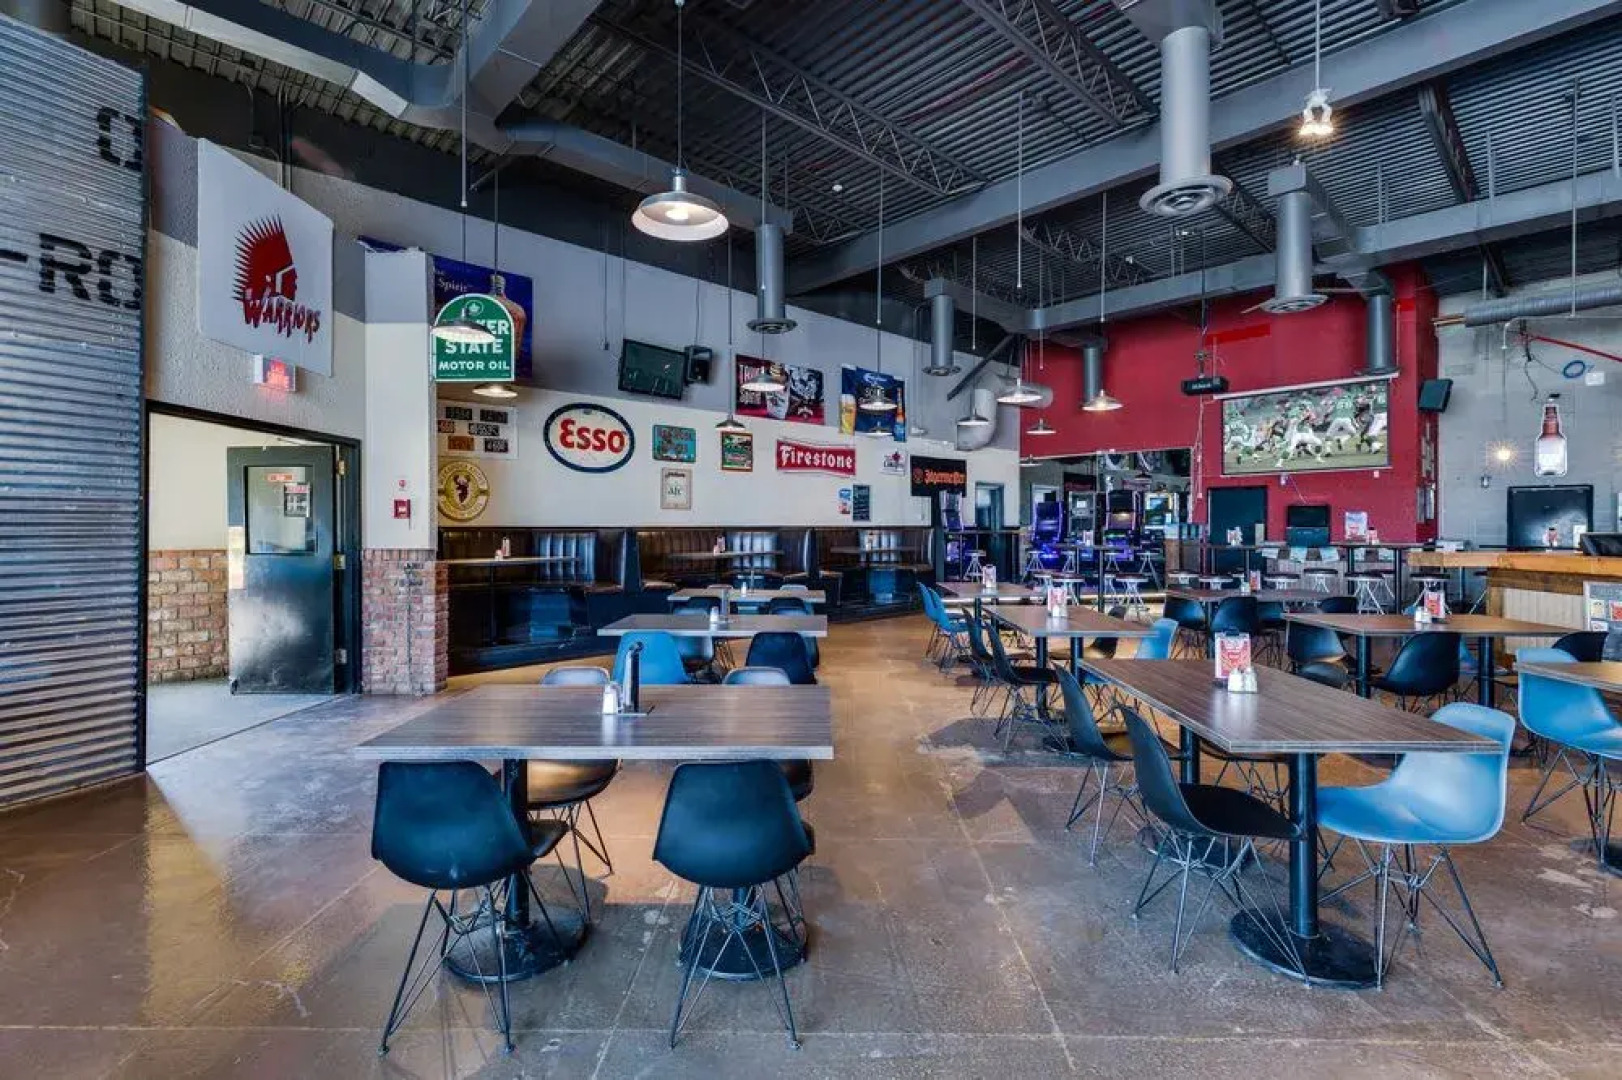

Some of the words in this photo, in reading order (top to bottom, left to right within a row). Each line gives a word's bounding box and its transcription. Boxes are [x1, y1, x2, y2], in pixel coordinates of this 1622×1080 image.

[445, 338, 504, 354] STATE
[438, 360, 485, 371] MOTOR
[488, 360, 510, 371] OIL
[780, 445, 853, 468] Firestone
